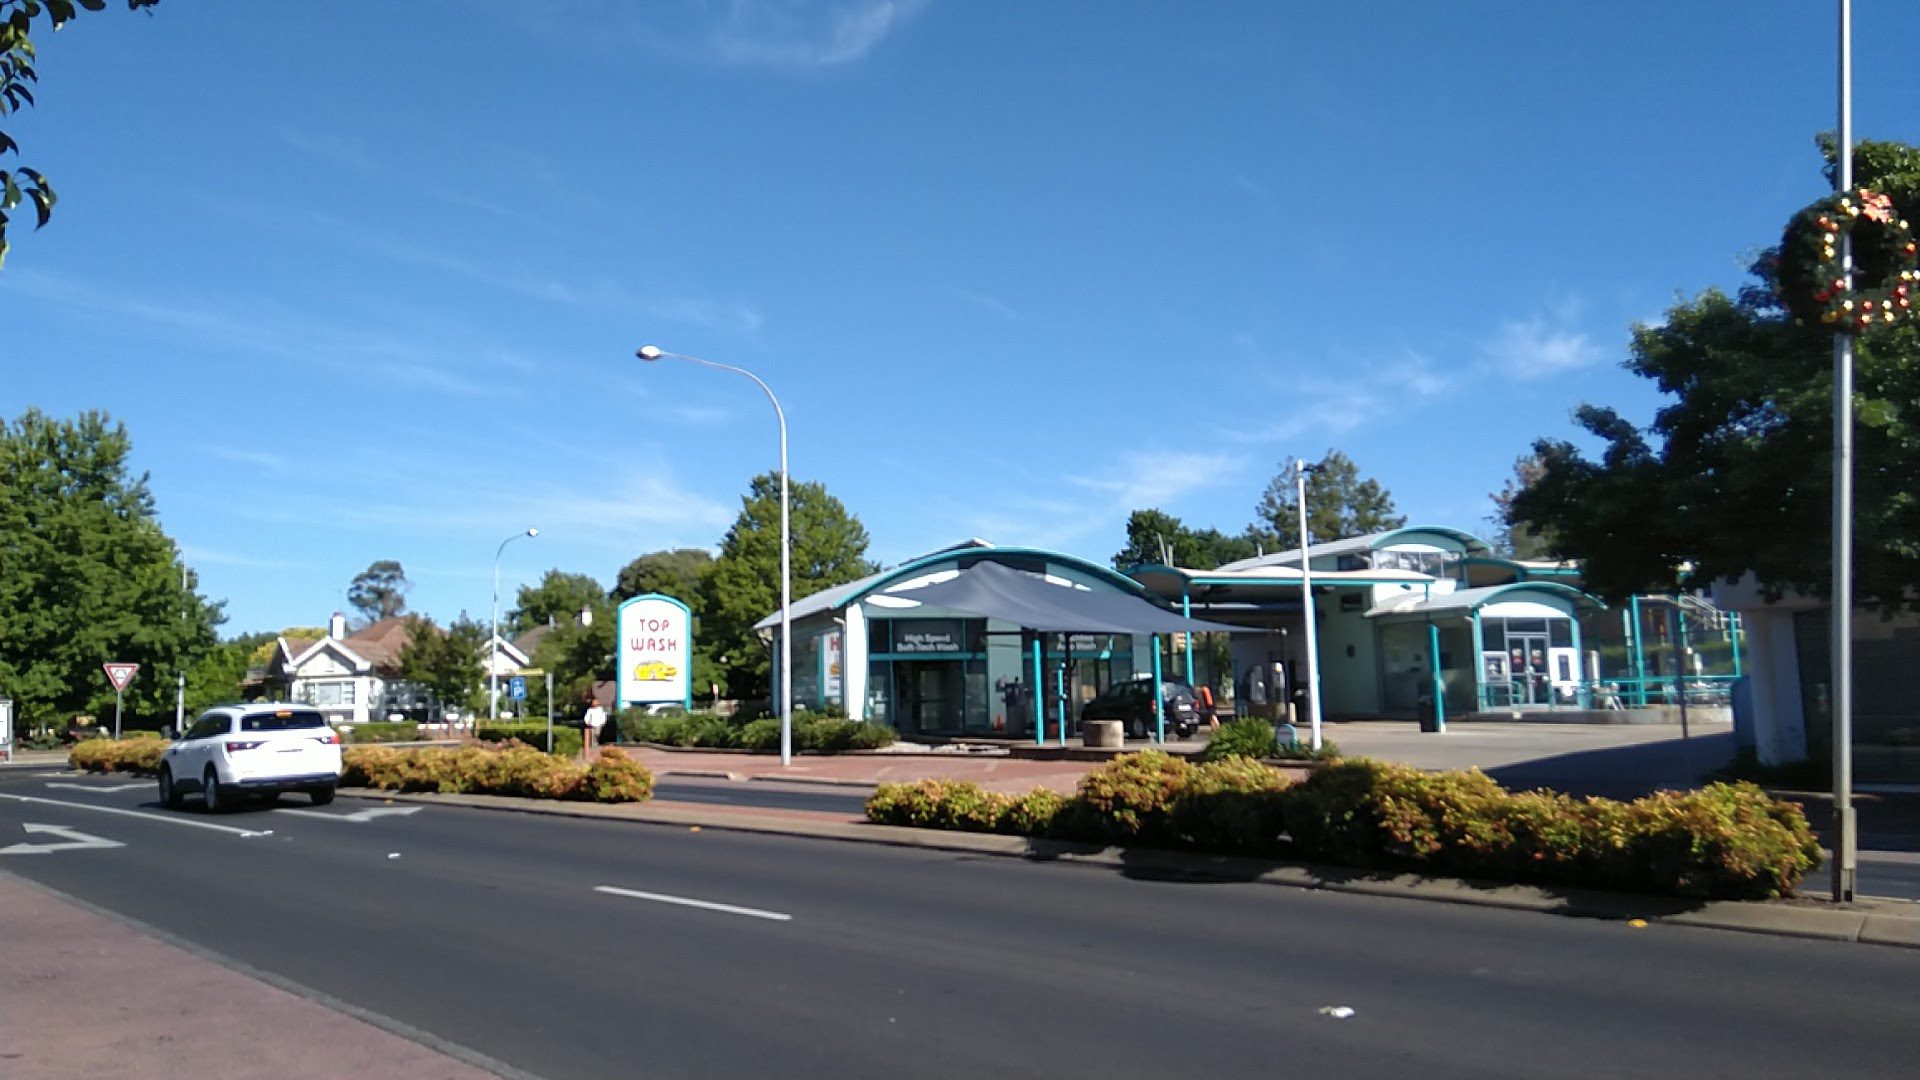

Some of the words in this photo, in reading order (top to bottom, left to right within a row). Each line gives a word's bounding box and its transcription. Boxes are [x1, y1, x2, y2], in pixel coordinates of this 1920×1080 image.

[639, 618, 670, 632] TOP
[904, 633, 924, 644] High
[925, 633, 950, 644] Speed
[631, 638, 676, 651] WASH
[936, 642, 960, 652] Wash
[1056, 642, 1075, 651] Auo
